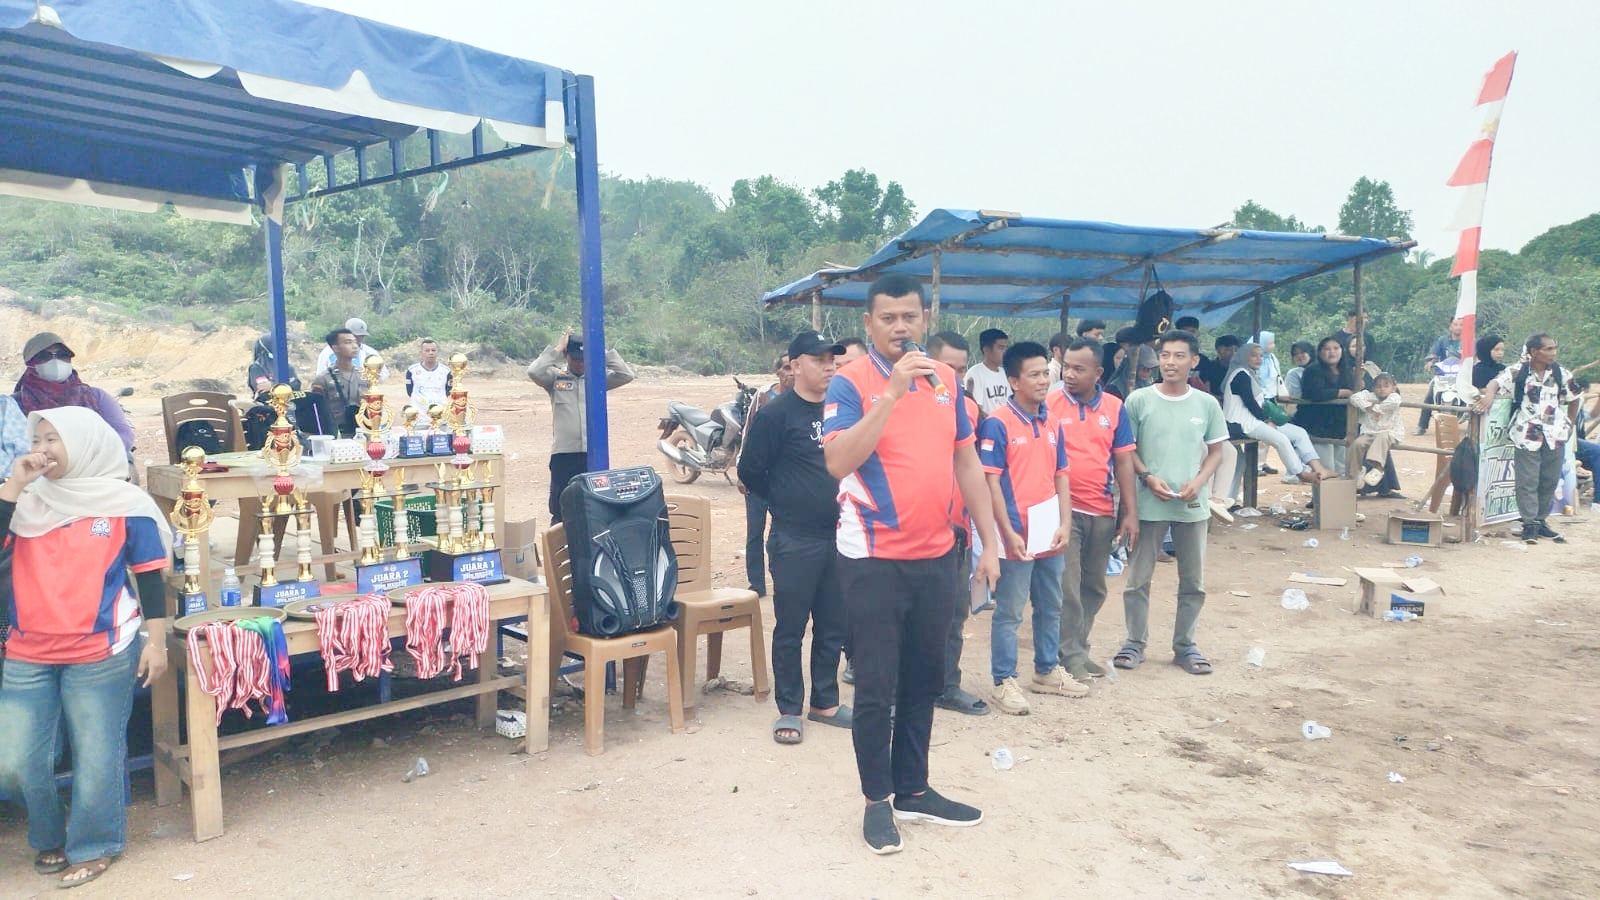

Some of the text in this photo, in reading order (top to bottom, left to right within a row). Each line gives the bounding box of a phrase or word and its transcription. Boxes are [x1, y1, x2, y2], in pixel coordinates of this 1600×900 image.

[460, 561, 488, 572] JUARA
[371, 570, 409, 583] JUARA 2
[274, 587, 306, 598] JUARA 3
